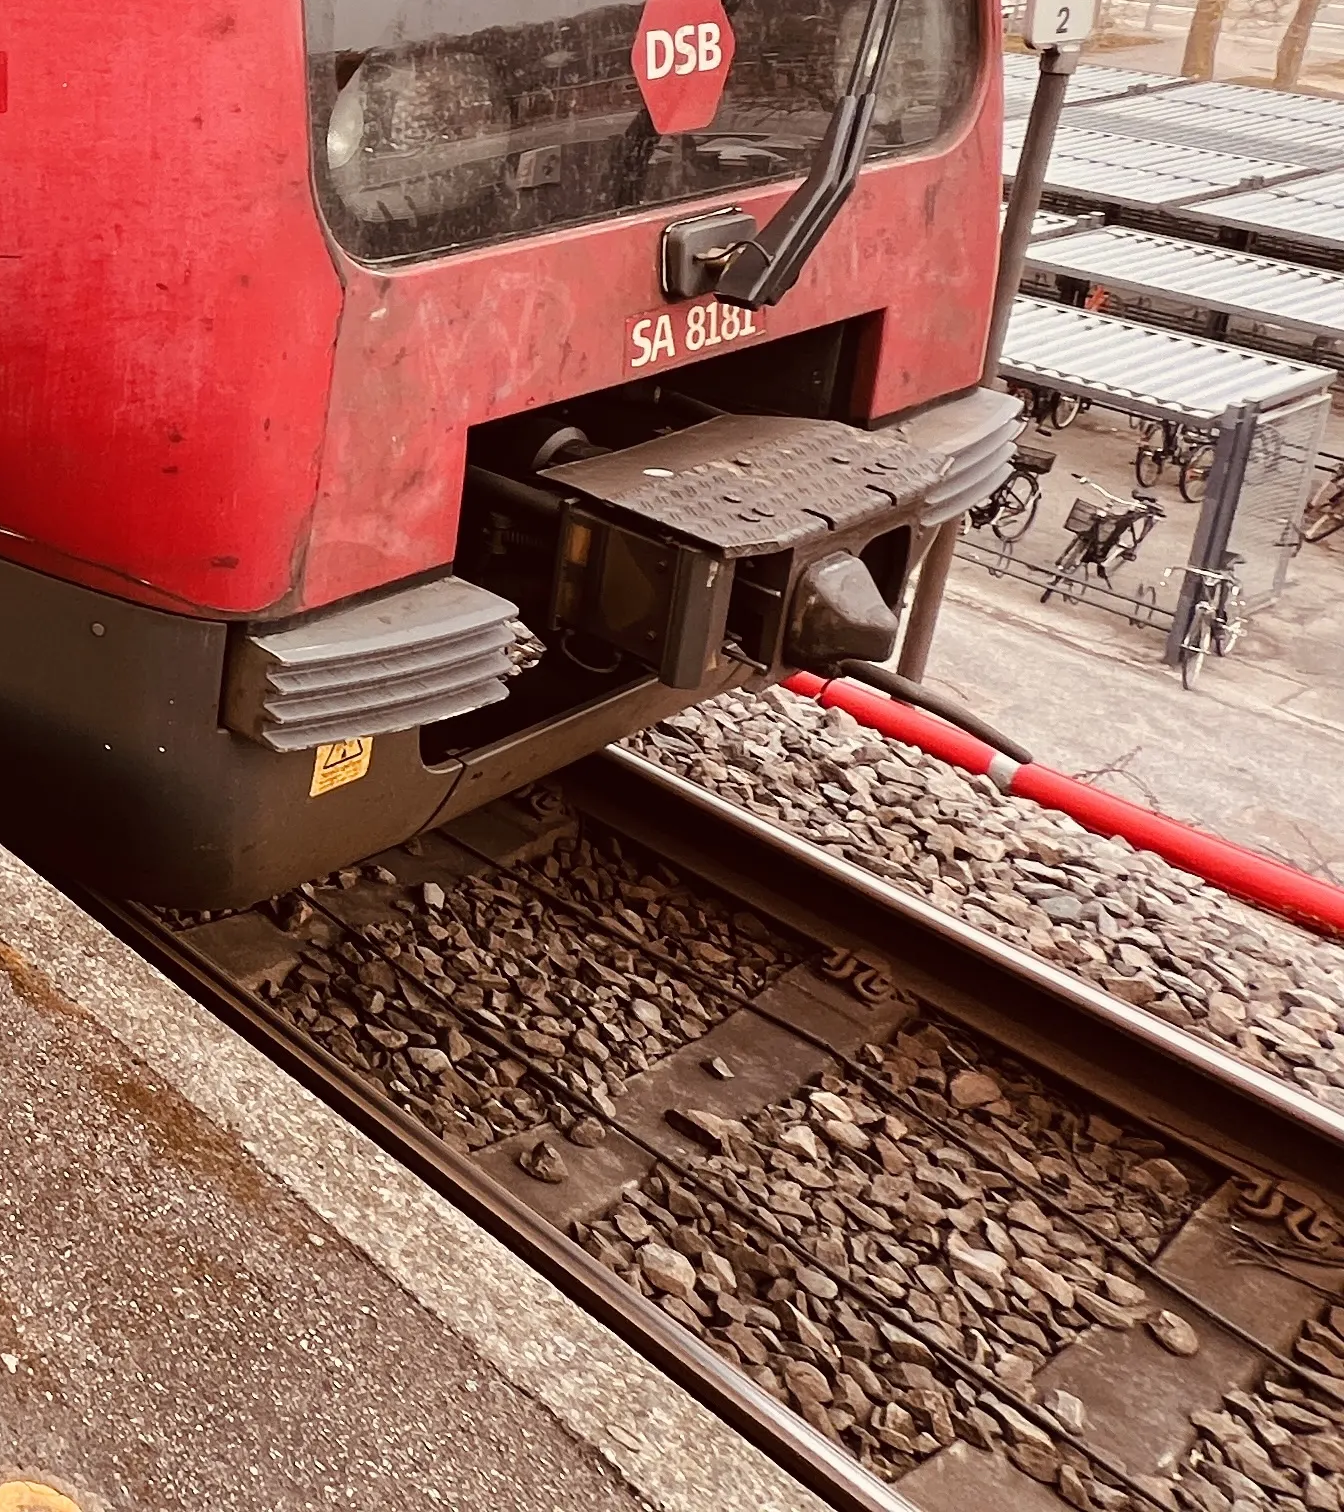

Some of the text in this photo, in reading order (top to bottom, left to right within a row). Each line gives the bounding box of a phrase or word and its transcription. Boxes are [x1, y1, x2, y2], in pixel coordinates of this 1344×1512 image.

[1055, 6, 1070, 34] 2
[646, 22, 722, 80] DSB
[631, 301, 756, 367] SA 8181
